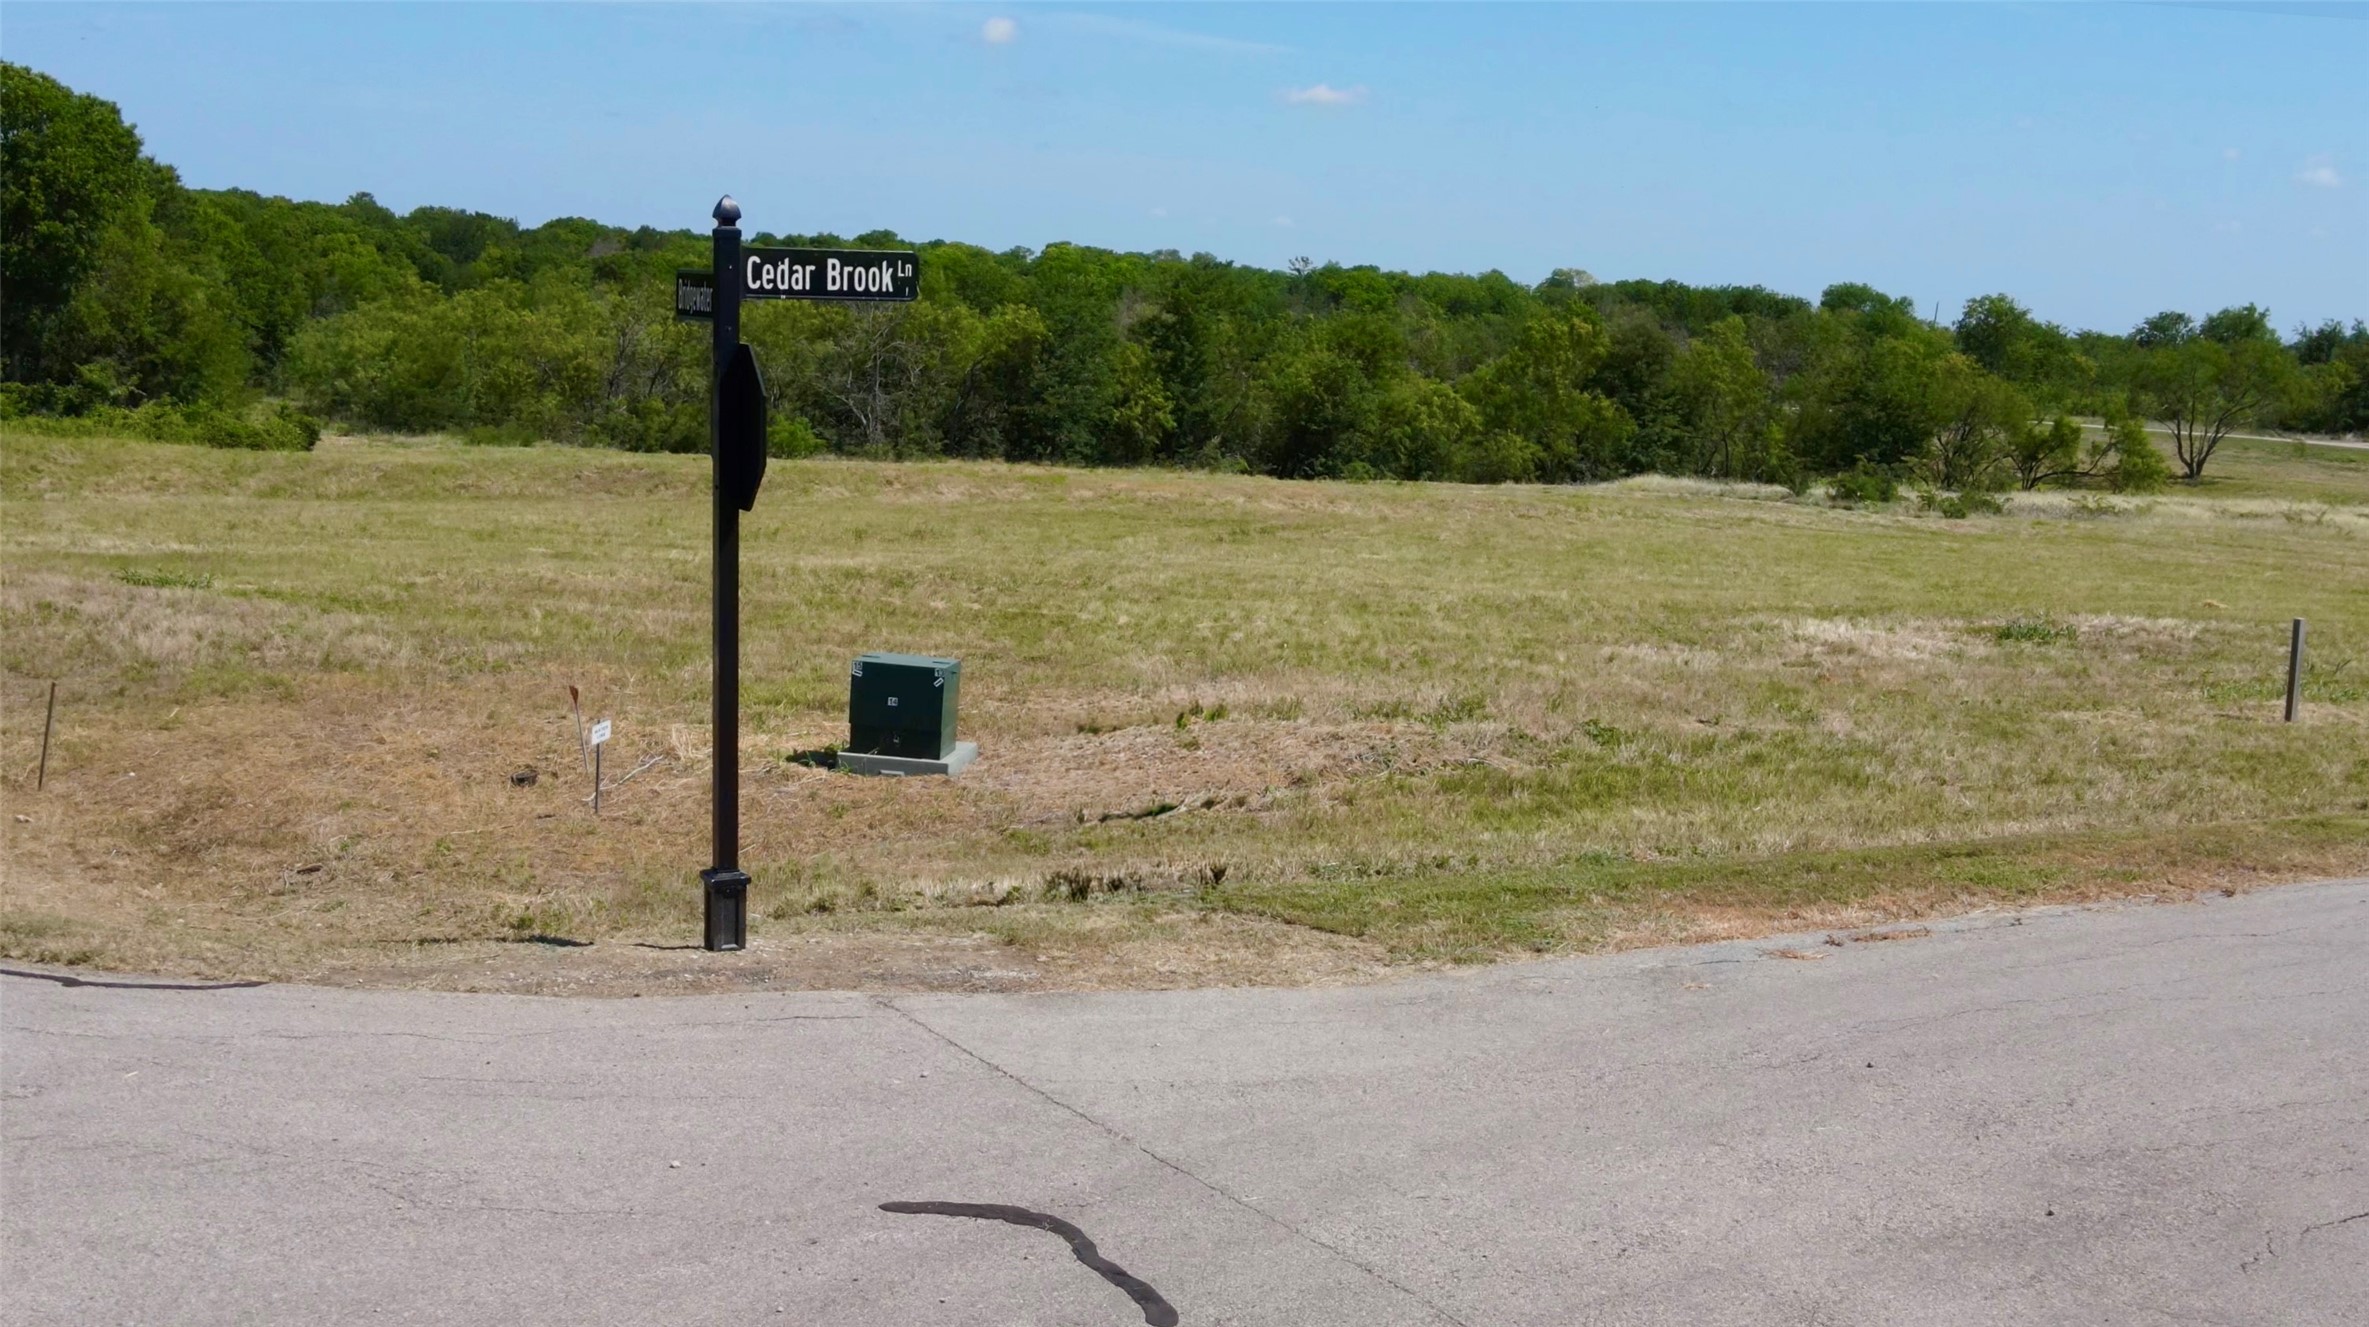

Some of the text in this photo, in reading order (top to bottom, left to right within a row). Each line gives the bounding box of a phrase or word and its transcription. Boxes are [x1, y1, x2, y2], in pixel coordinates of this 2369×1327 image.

[746, 255, 912, 292] Cedar Brook Ln
[678, 278, 713, 315] Bridgewater
